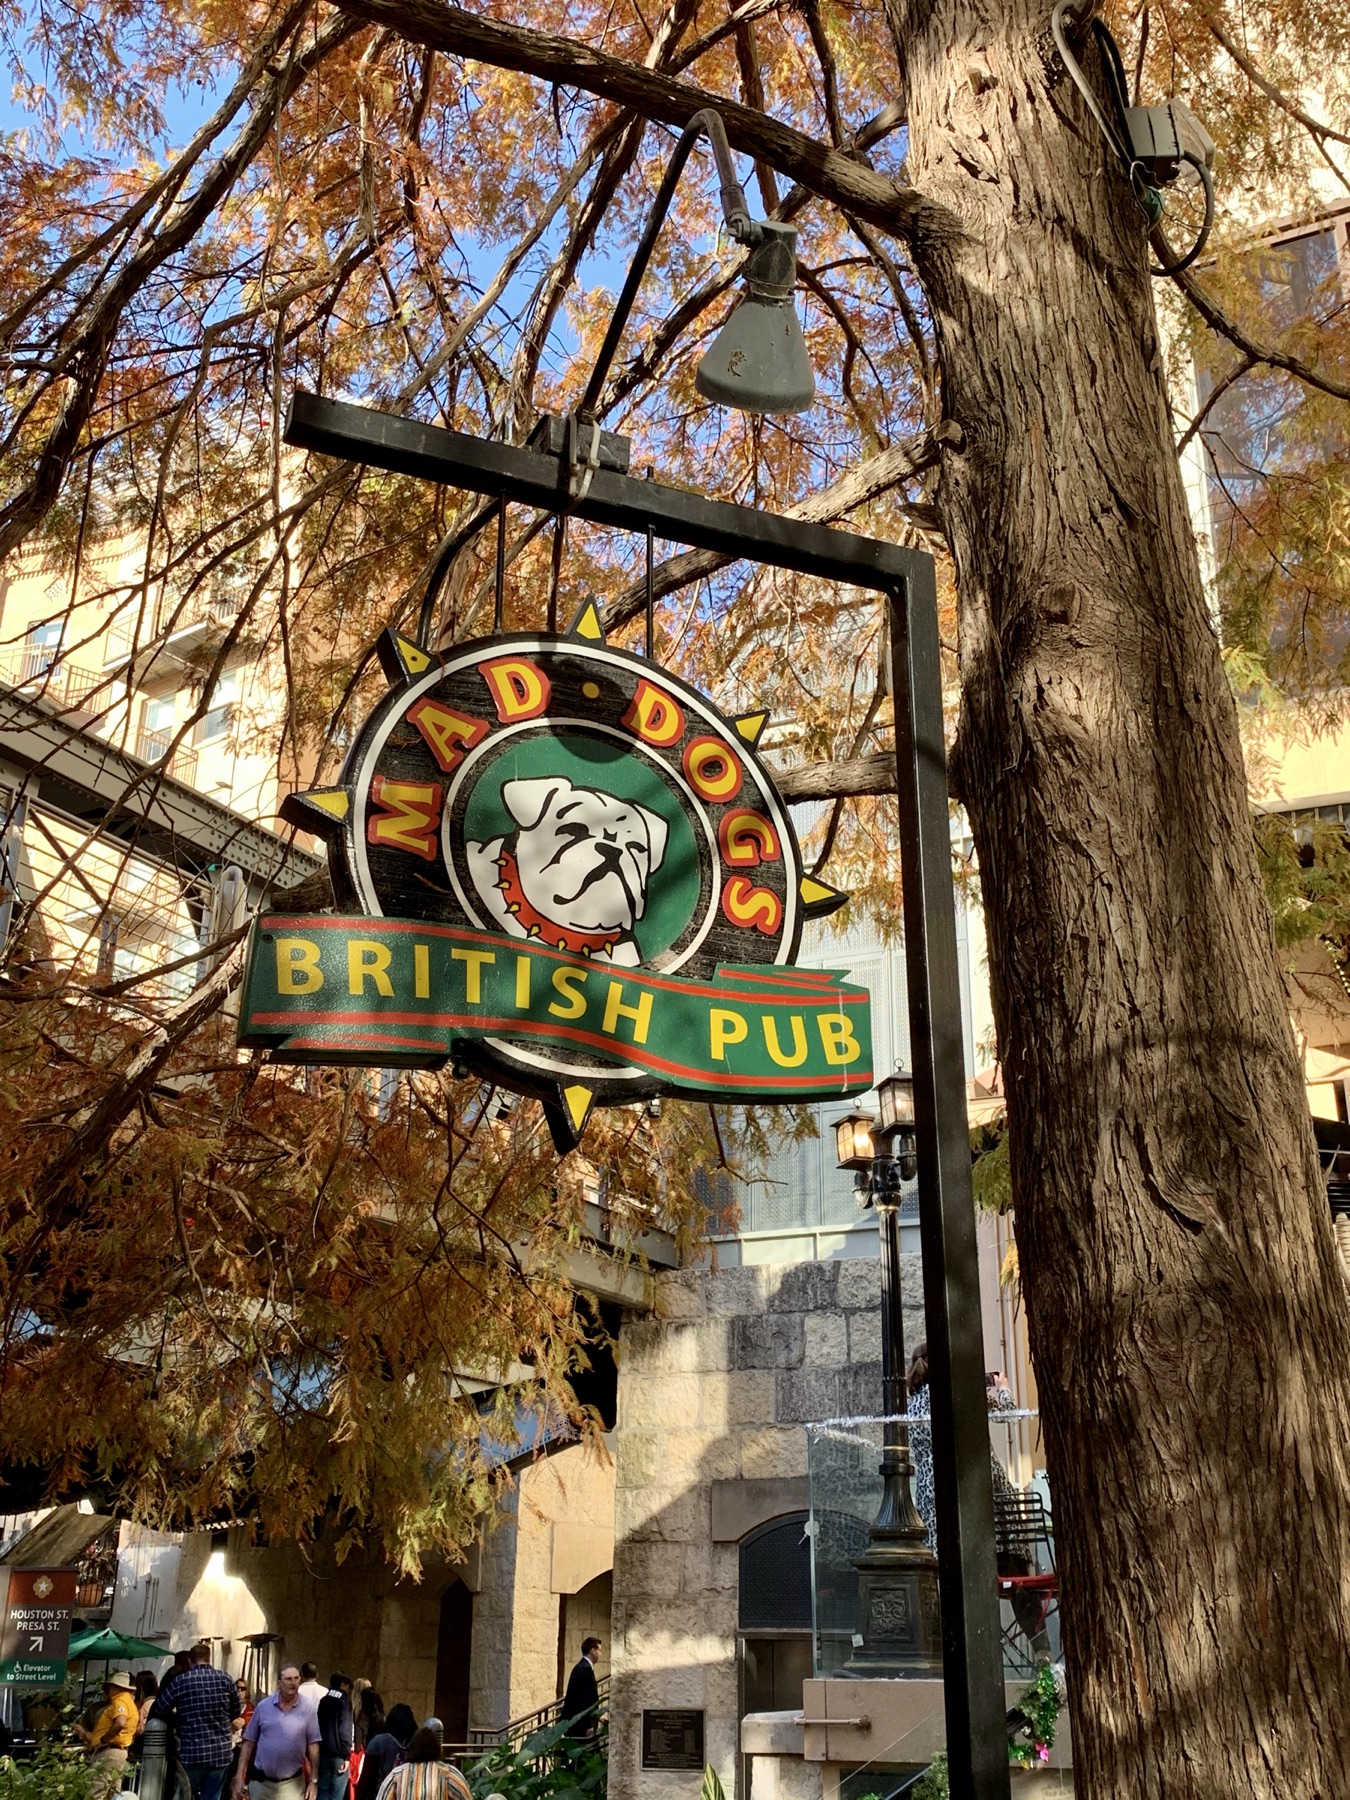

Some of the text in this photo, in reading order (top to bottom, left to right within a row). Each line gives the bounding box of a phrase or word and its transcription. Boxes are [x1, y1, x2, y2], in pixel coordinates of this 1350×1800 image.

[368, 657, 782, 935] MAD DOGS
[275, 937, 862, 1068] BRITISH PUB
[10, 1610, 69, 1619] HOUSTON ST.
[16, 1621, 60, 1631] PRESA ST.
[23, 1664, 51, 1672] Elevator
[6, 1673, 57, 1681] to Street Level
